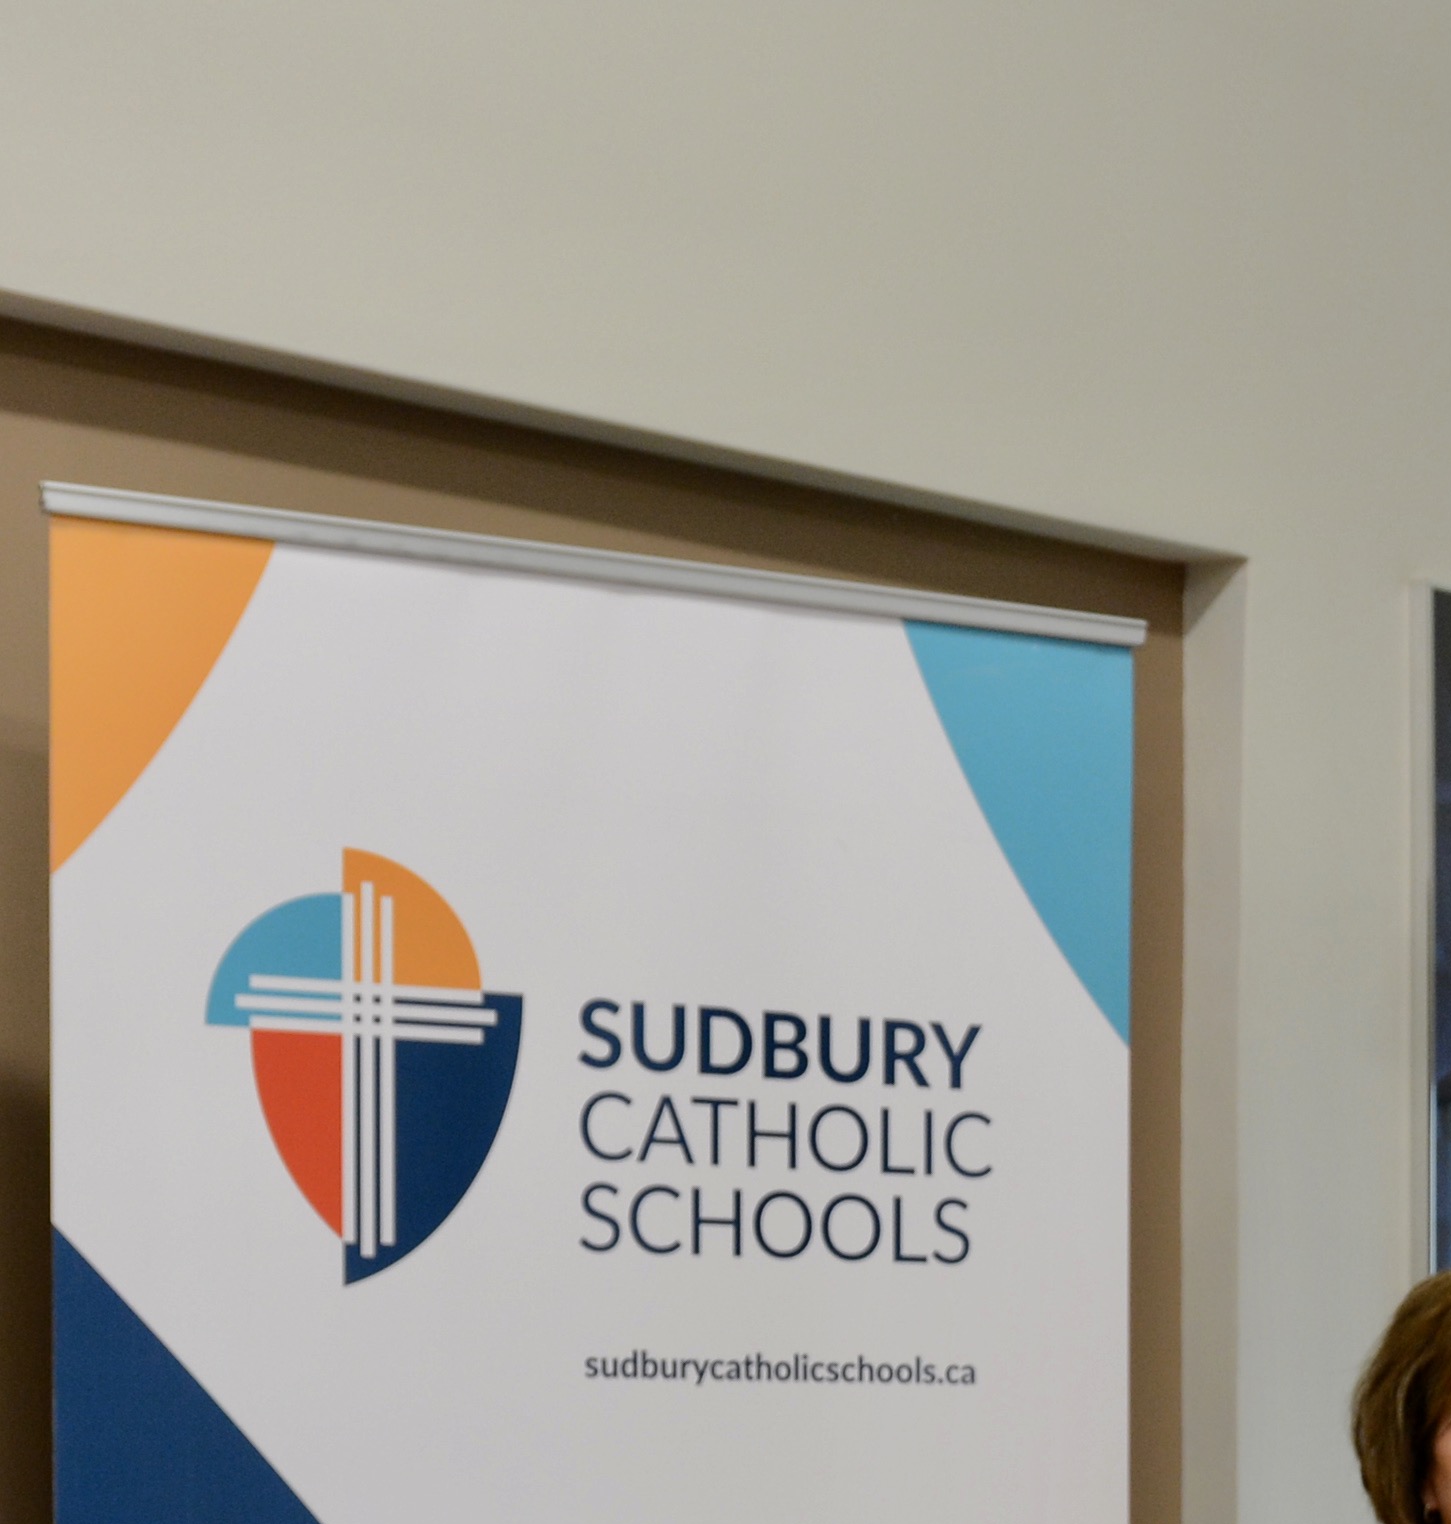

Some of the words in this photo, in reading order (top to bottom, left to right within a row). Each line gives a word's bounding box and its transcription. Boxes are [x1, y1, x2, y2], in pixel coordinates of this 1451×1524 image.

[580, 1000, 980, 1089] SUDBURY
[581, 1092, 991, 1178] CATHOLIC
[581, 1183, 969, 1264] SCHOOLS
[586, 1350, 975, 1385] sudburycatholicschools.ca
